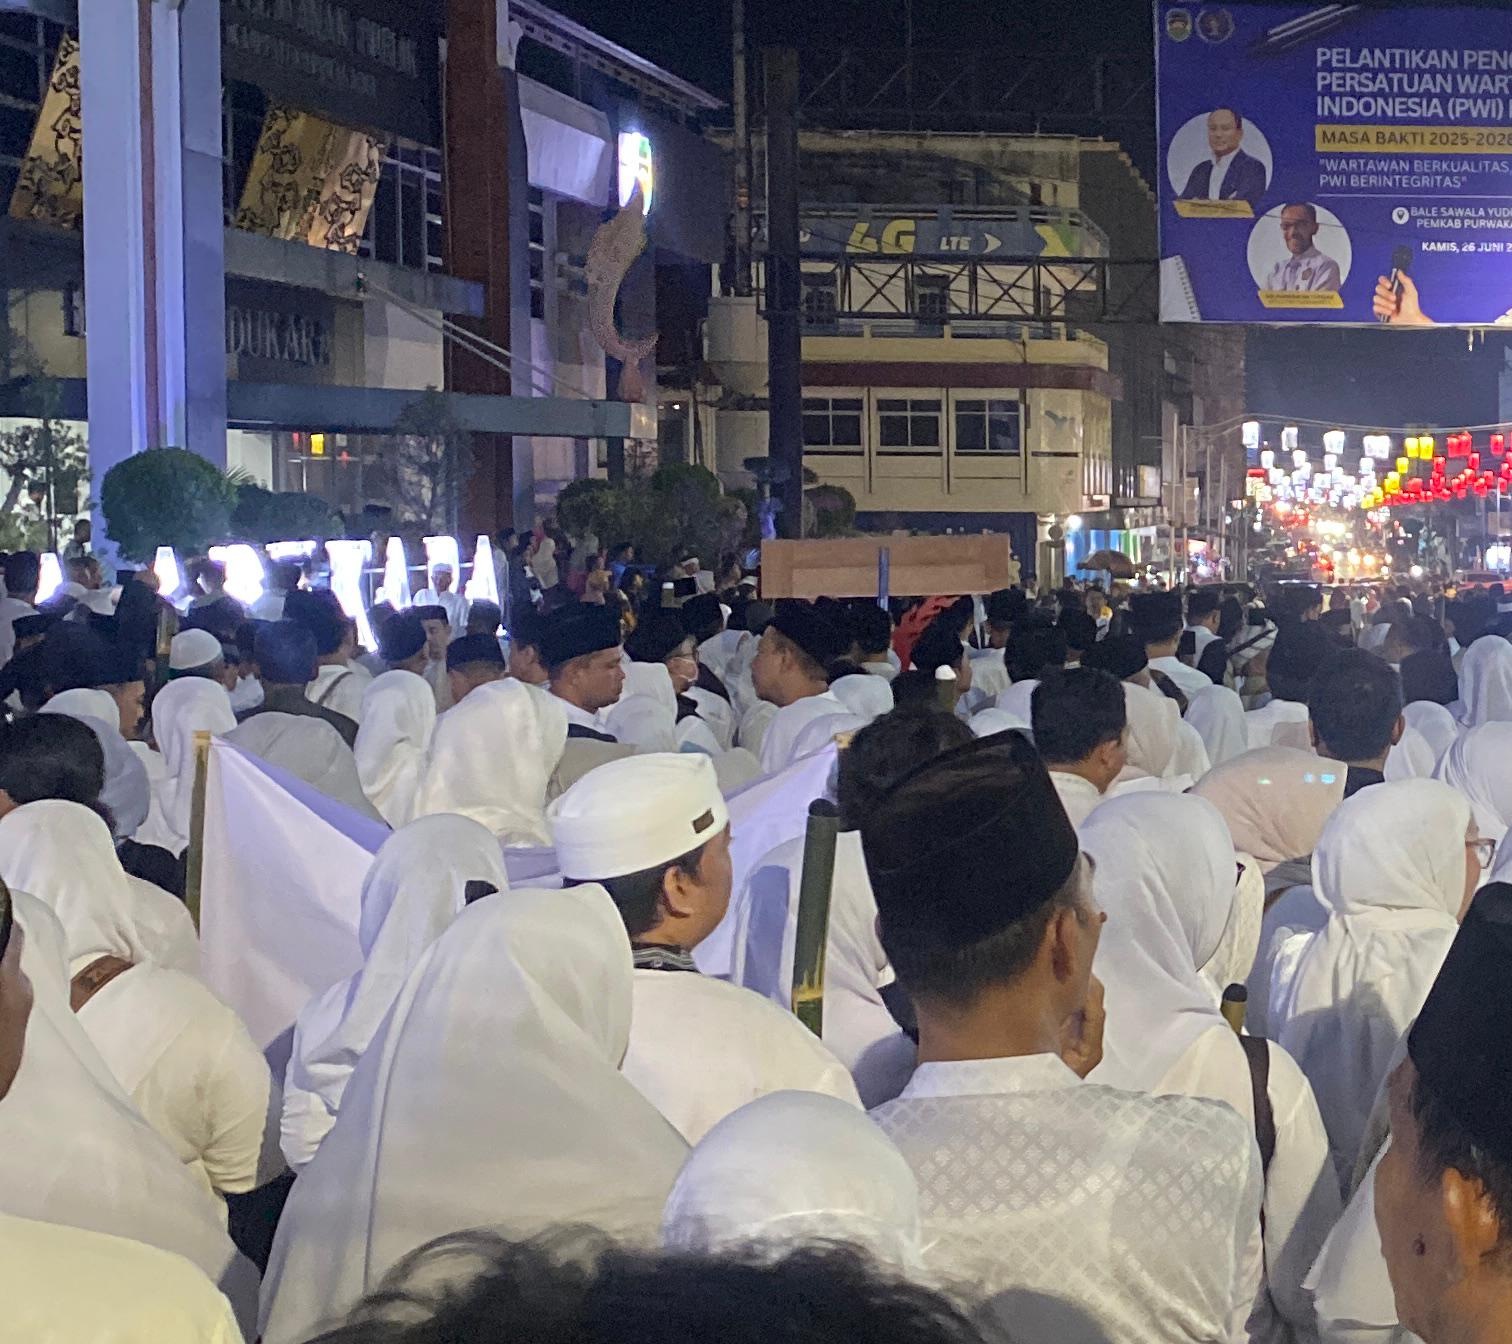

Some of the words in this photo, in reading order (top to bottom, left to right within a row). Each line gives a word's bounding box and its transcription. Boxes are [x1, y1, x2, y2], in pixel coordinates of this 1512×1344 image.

[1316, 47, 1458, 70] PELANTIKAN
[1316, 72, 1451, 93] PERSATUAN
[1316, 96, 1444, 118] INDONESIA
[1447, 97, 1504, 120] (PWI)
[1321, 130, 1370, 145] MASA
[1375, 131, 1425, 145] BAKTI
[1319, 158, 1410, 172] "WARTAWAN
[1413, 160, 1512, 175] BERKUALITAS,
[1319, 174, 1347, 187] PWI
[1350, 174, 1467, 188] BERINTEGRITAS"
[1410, 206, 1438, 217] BALE
[1440, 207, 1485, 217] SAWALA
[1416, 218, 1461, 228] PEMKAB
[845, 219, 915, 254] 4G
[939, 236, 972, 250] LTE
[1421, 242, 1459, 253] KAMIS,
[1461, 242, 1475, 252] 26
[1477, 242, 1504, 252] JUNI
